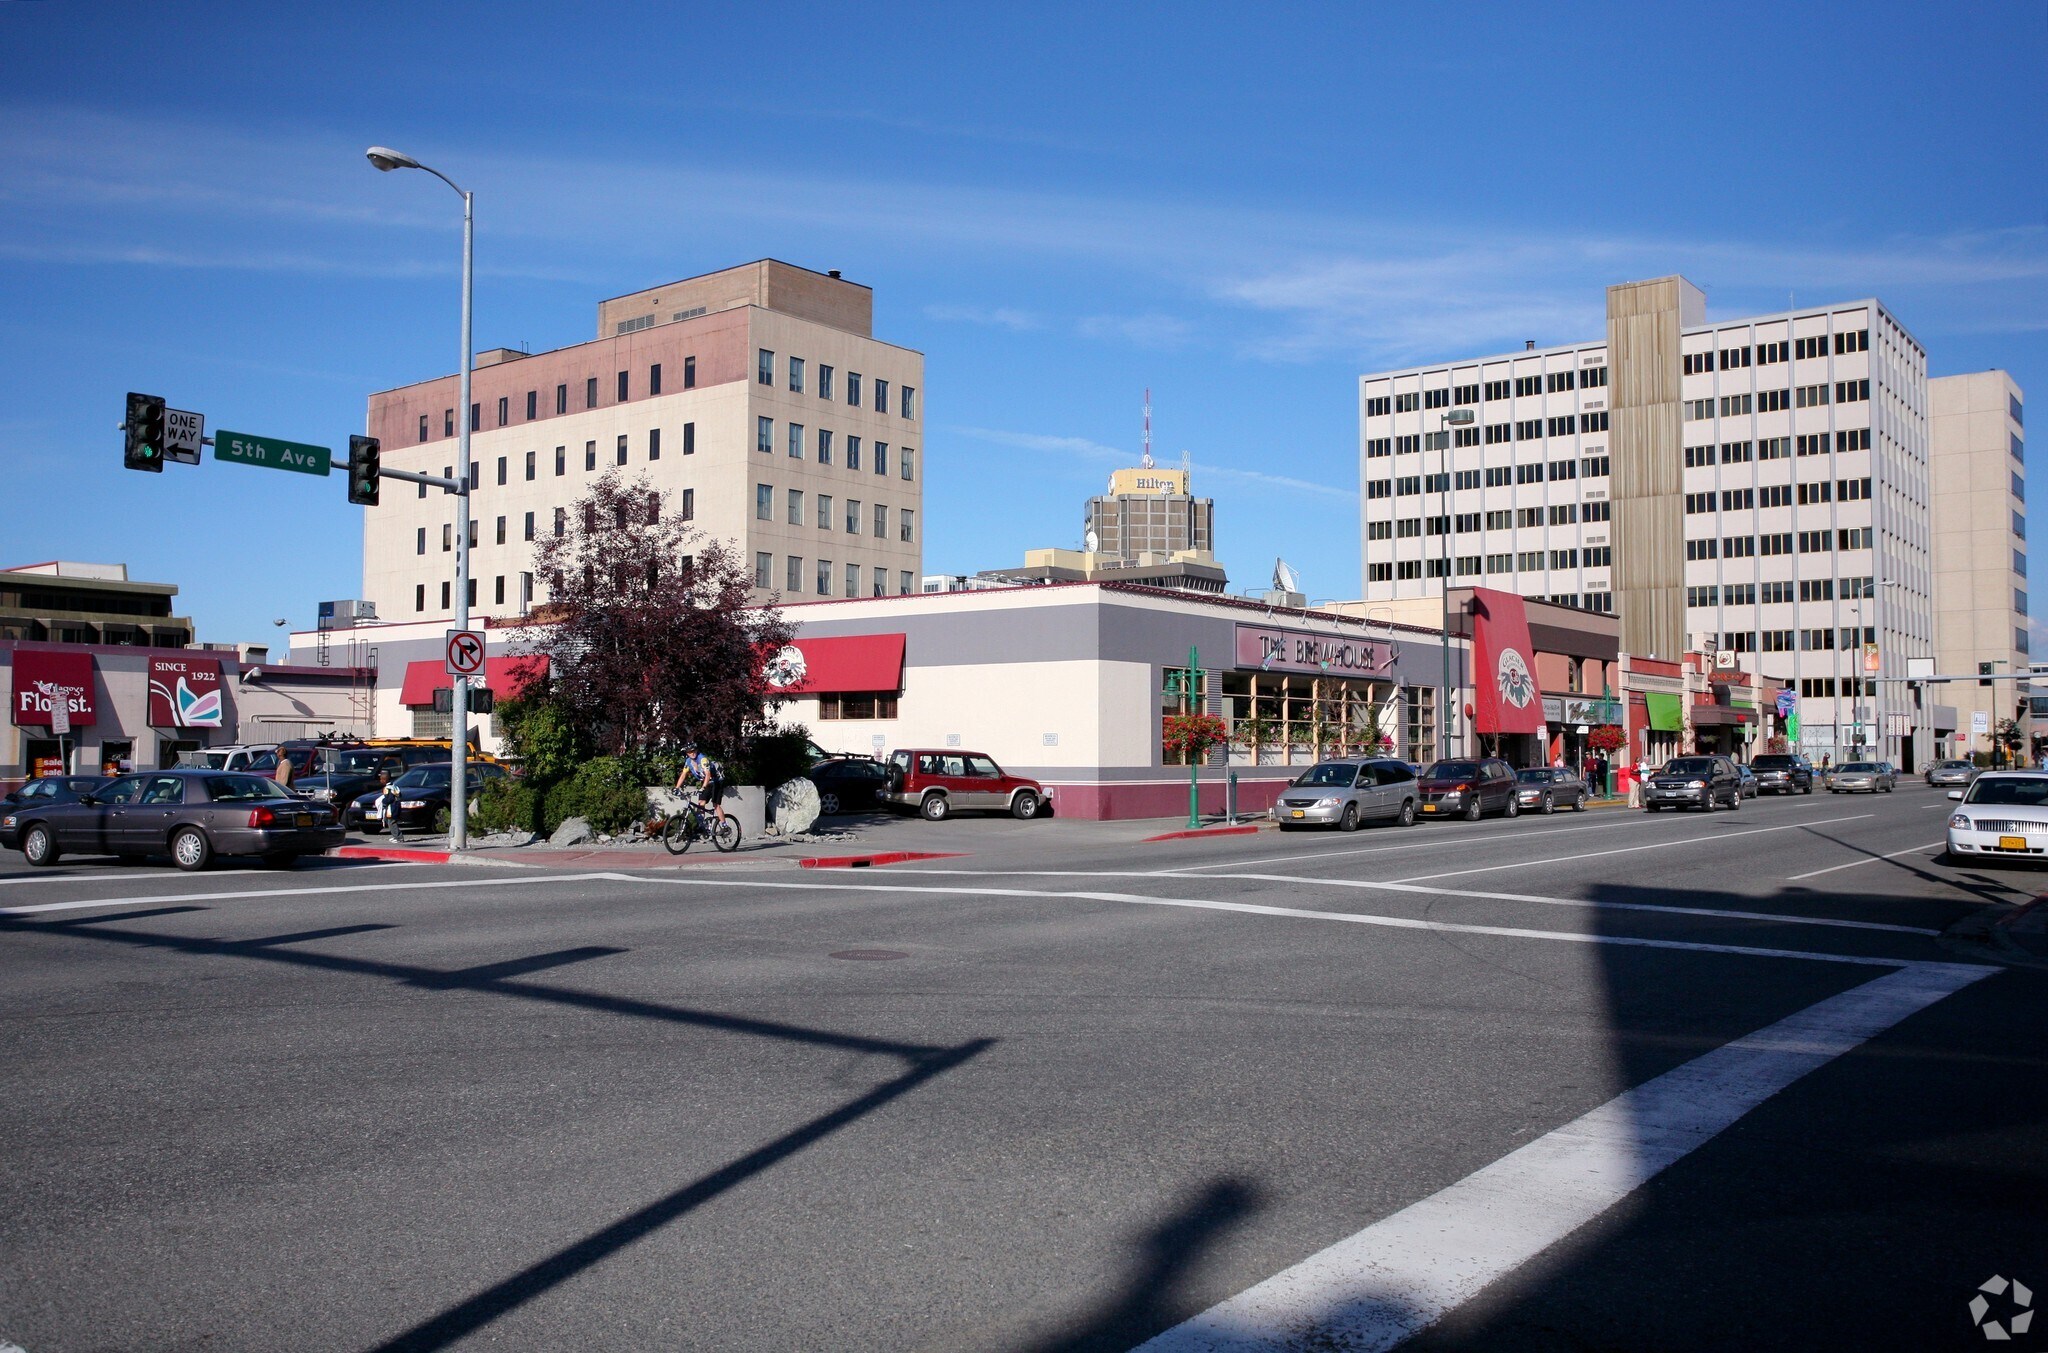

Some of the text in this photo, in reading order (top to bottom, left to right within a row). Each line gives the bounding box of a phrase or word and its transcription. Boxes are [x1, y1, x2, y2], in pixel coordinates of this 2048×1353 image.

[169, 413, 197, 429] ONE
[167, 426, 197, 442] WAY
[231, 440, 317, 468] 5th Ave
[1136, 477, 1175, 490] Hilton
[1259, 635, 1375, 670] THE BREWHOUSE
[155, 662, 187, 672] SINCE
[191, 671, 216, 682] 1922
[52, 685, 85, 697] agoys
[20, 691, 92, 713] Flost.
[43, 758, 63, 766] sale
[43, 768, 63, 776] sale
